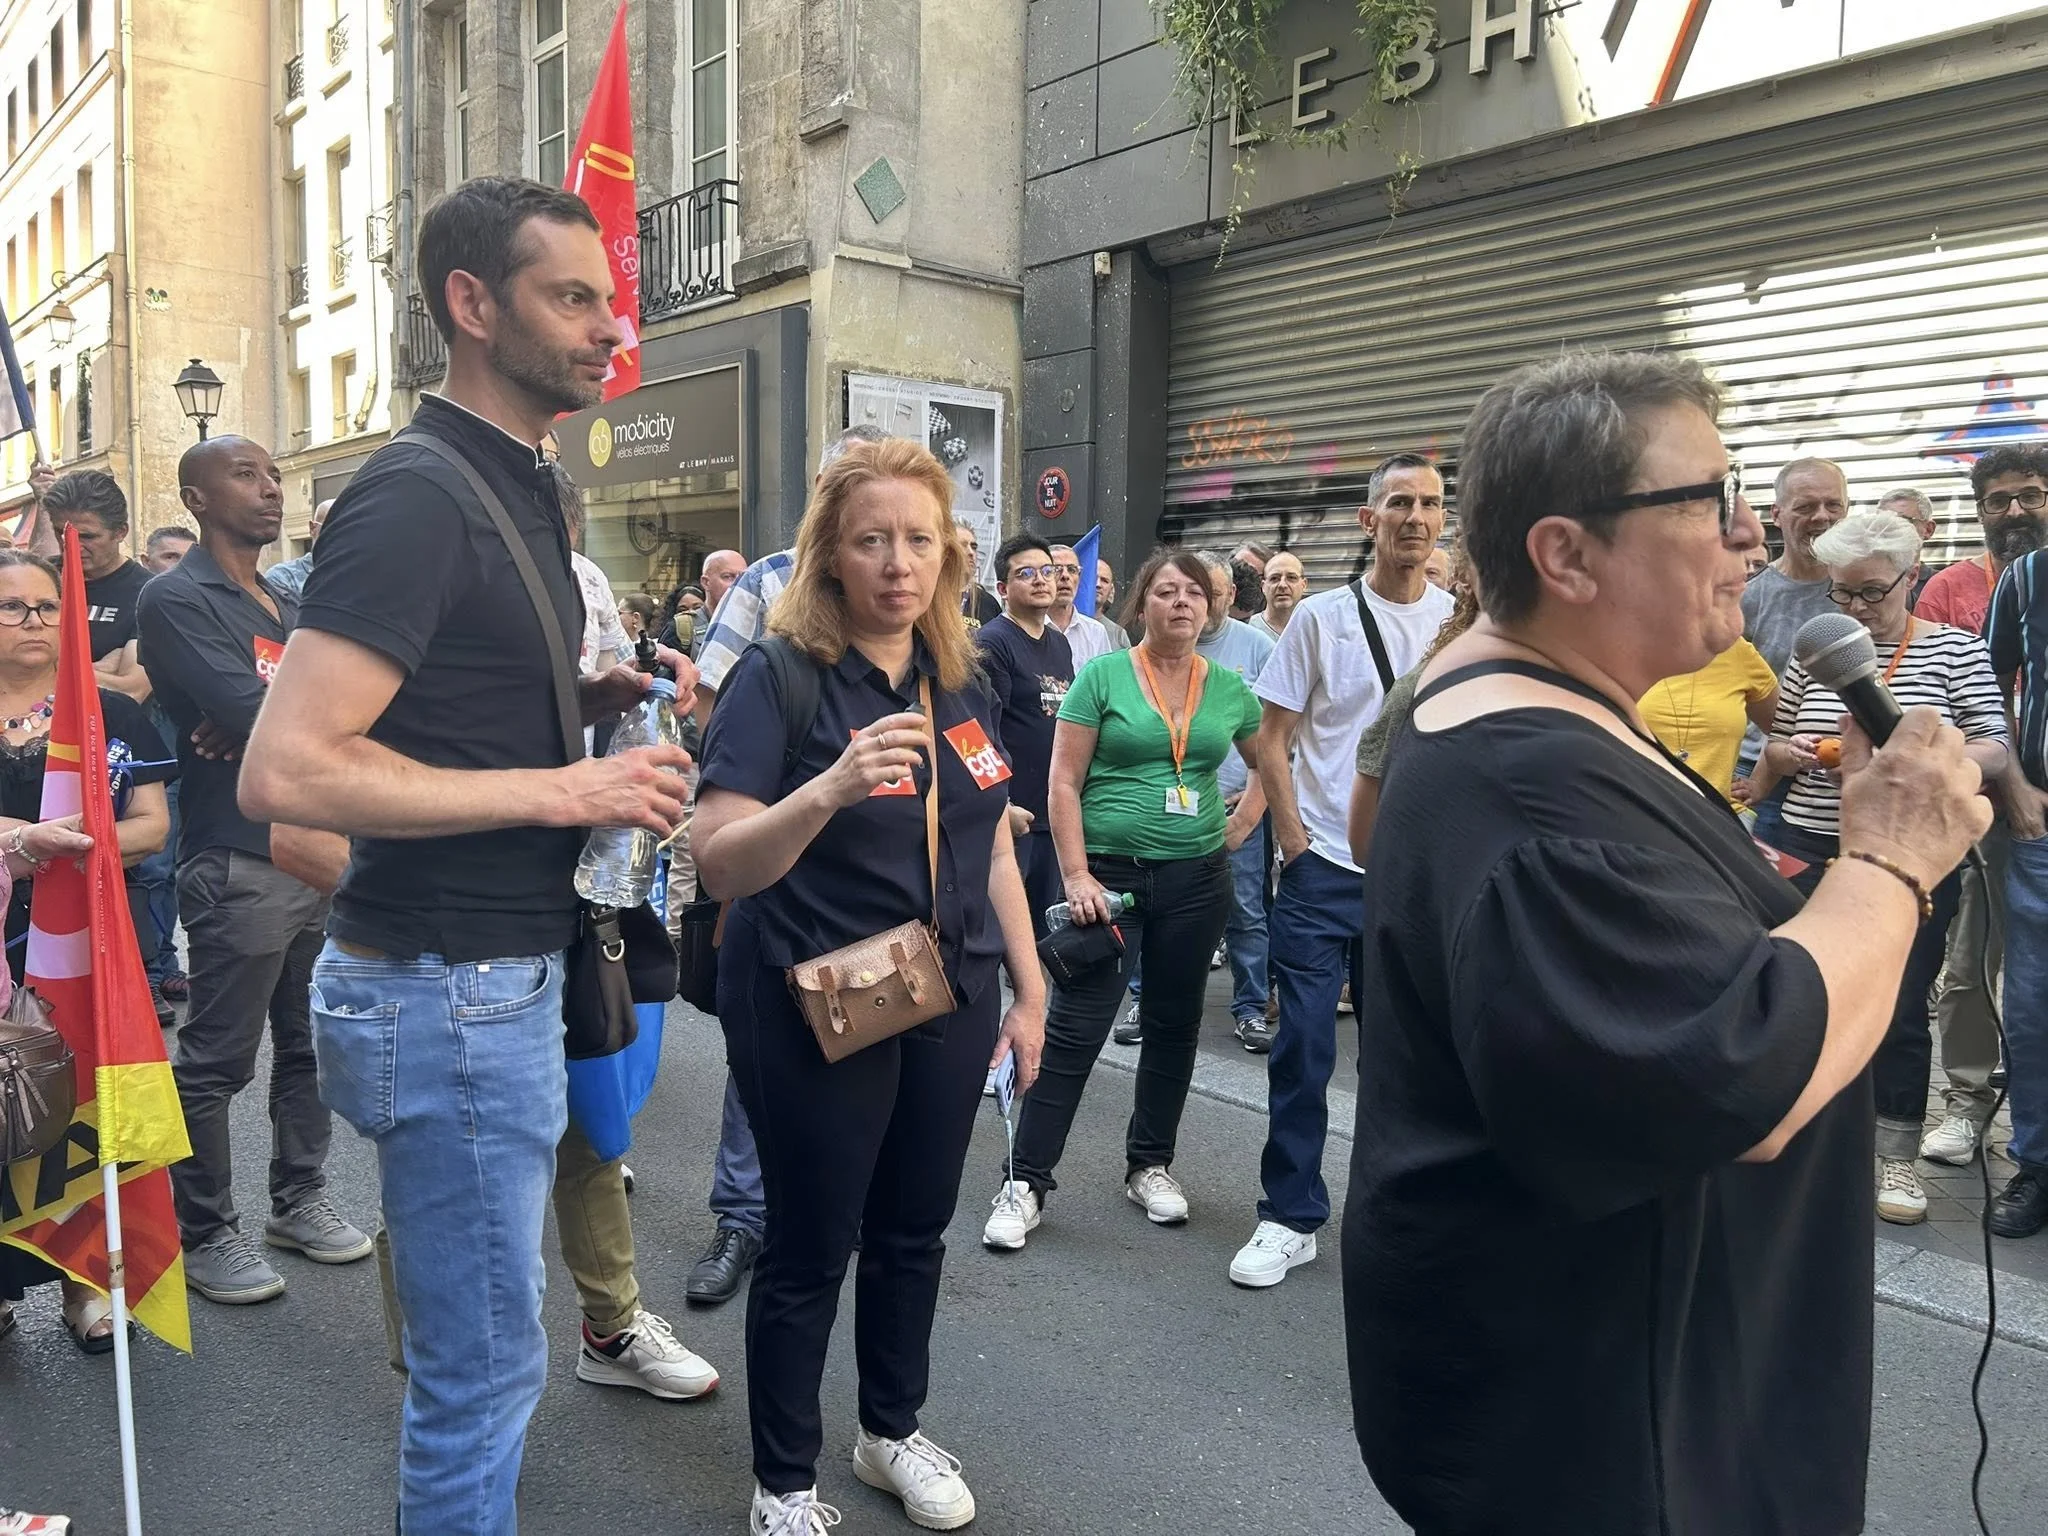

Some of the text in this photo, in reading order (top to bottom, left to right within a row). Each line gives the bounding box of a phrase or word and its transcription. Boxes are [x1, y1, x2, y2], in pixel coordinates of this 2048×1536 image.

[1229, 47, 1336, 148] LE
[614, 412, 675, 443] mobicity
[633, 442, 670, 457] électriques
[1044, 476, 1059, 486] JOUR
[1046, 487, 1055, 497] ET
[1044, 498, 1057, 508] NUIT
[961, 737, 988, 760] la
[965, 744, 1004, 779] cgt
